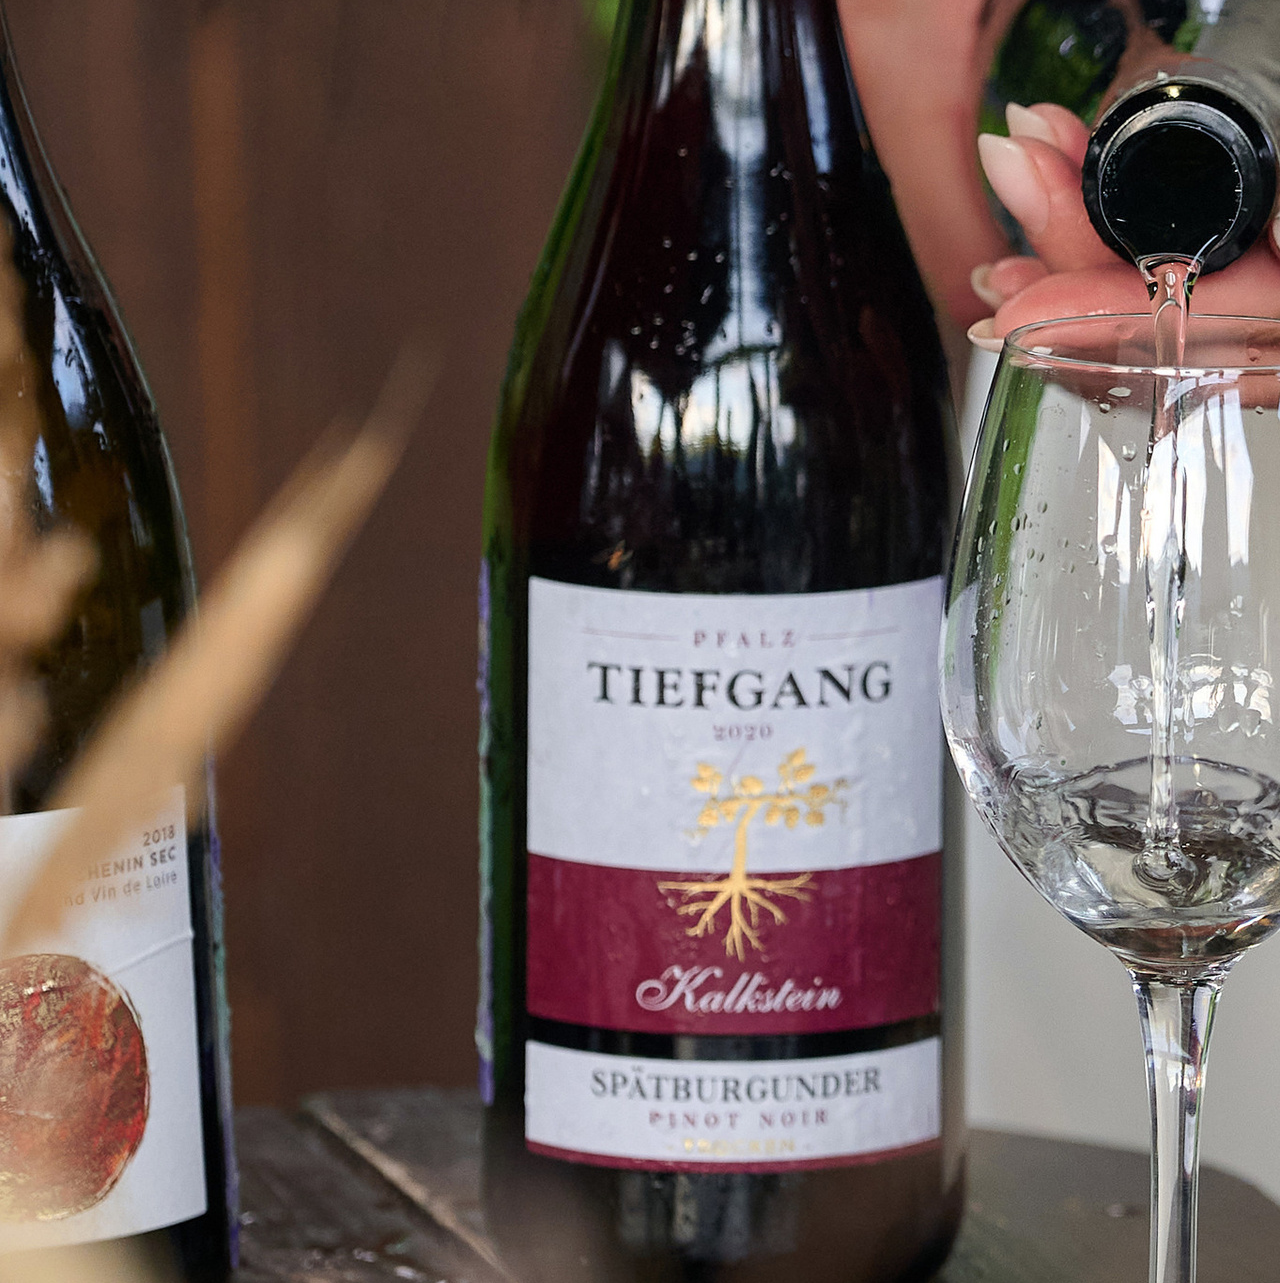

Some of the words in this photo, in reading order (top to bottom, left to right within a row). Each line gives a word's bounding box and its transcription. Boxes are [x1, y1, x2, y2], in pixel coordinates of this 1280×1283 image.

[692, 629, 797, 649] PFALZ
[586, 660, 893, 711] TIEFGANG
[713, 723, 775, 742] 2020
[142, 824, 175, 848] 2018
[79, 855, 144, 882] HENIN
[149, 845, 176, 868] SEC
[92, 885, 117, 904] Vin
[122, 879, 141, 897] de
[145, 871, 178, 892] Loire
[635, 964, 844, 1014] Kalkstein
[591, 1065, 883, 1104] SPÄTBURGUNDER
[648, 1110, 739, 1130] PINOT
[759, 1109, 829, 1128] NOIR
